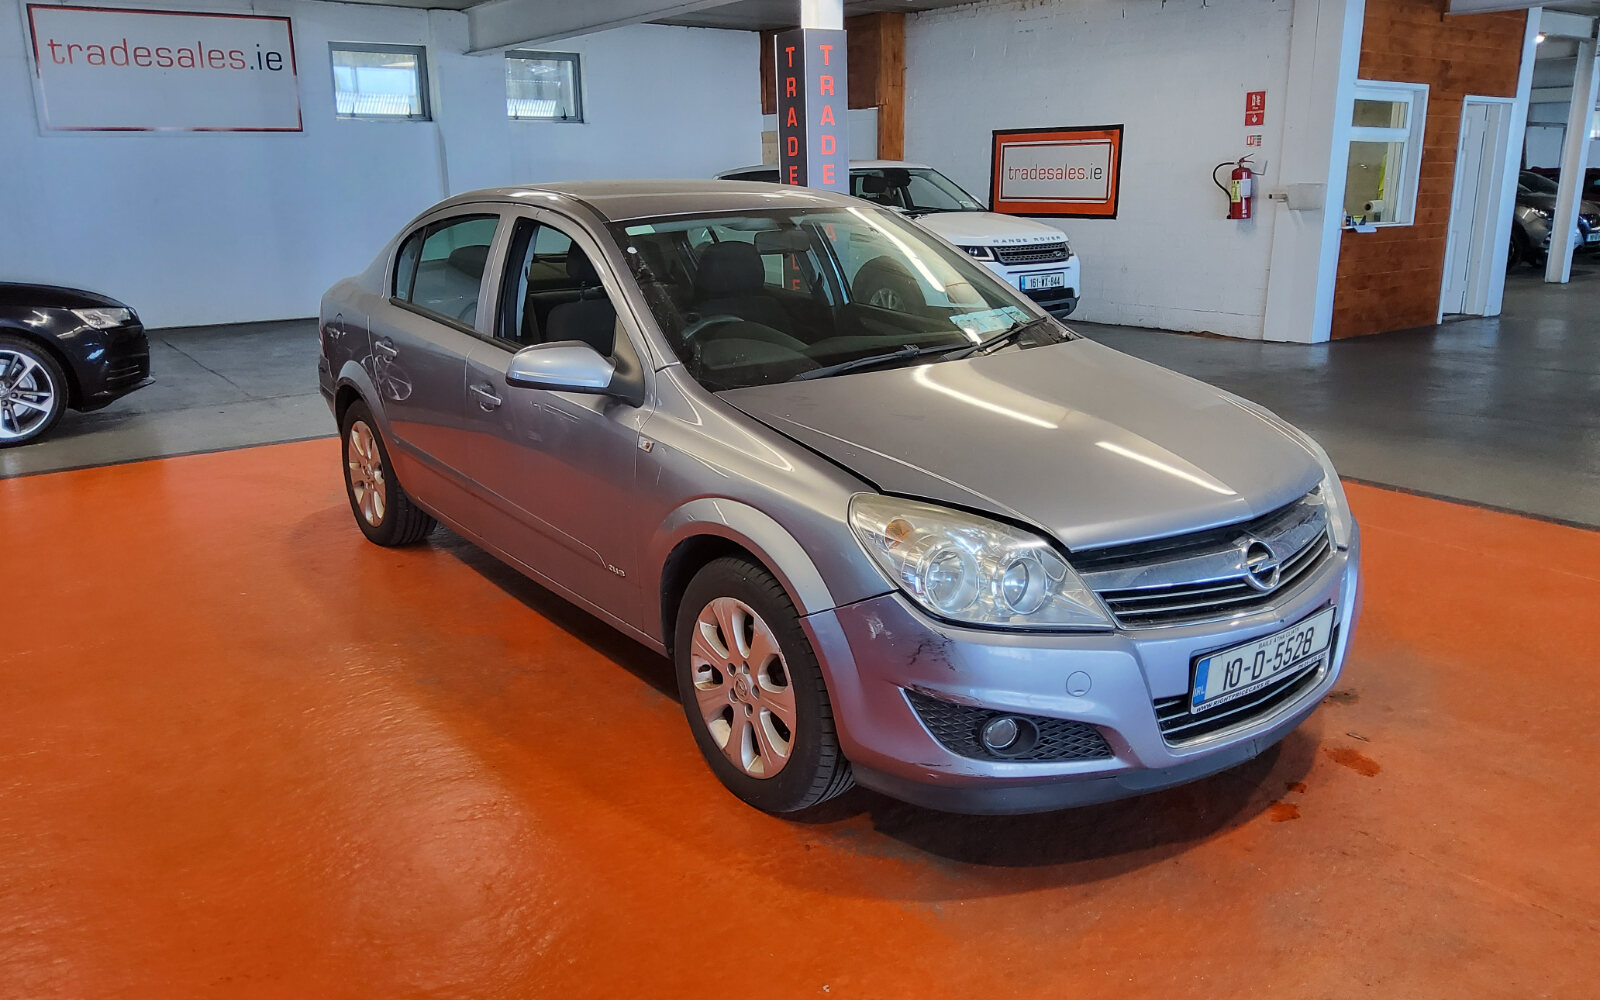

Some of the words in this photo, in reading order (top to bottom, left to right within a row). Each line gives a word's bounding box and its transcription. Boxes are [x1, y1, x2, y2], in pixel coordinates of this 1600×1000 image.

[47, 38, 283, 71] tradesales.ie
[786, 46, 799, 185] TRADE
[819, 44, 836, 184] TRADE
[1008, 163, 1102, 180] tradesales.ie
[1222, 626, 1315, 691] 10-D-5528
